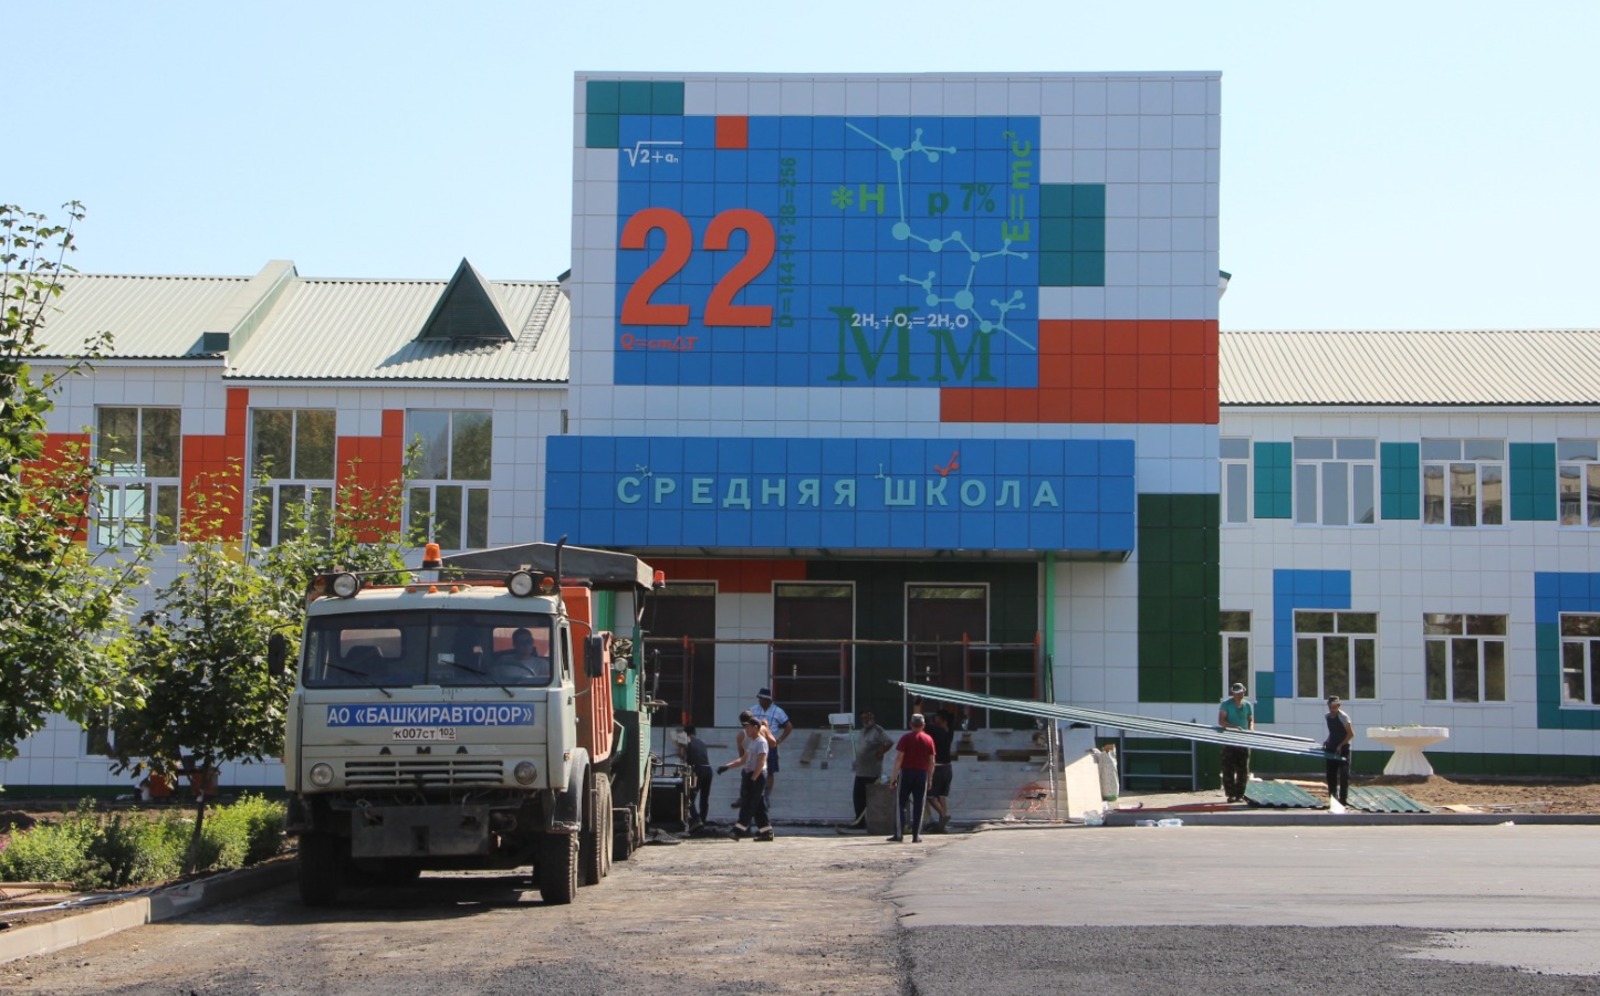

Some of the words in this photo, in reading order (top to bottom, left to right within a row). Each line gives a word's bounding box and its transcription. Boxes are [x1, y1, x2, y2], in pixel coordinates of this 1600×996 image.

[619, 207, 777, 327] 22
[616, 476, 856, 510] СРЕДНЯЯ
[884, 477, 1059, 508] ШКОЛА
[327, 708, 350, 724] АО
[355, 706, 533, 726] «БАШКИРАВТОДОР»
[439, 727, 455, 737] 102
